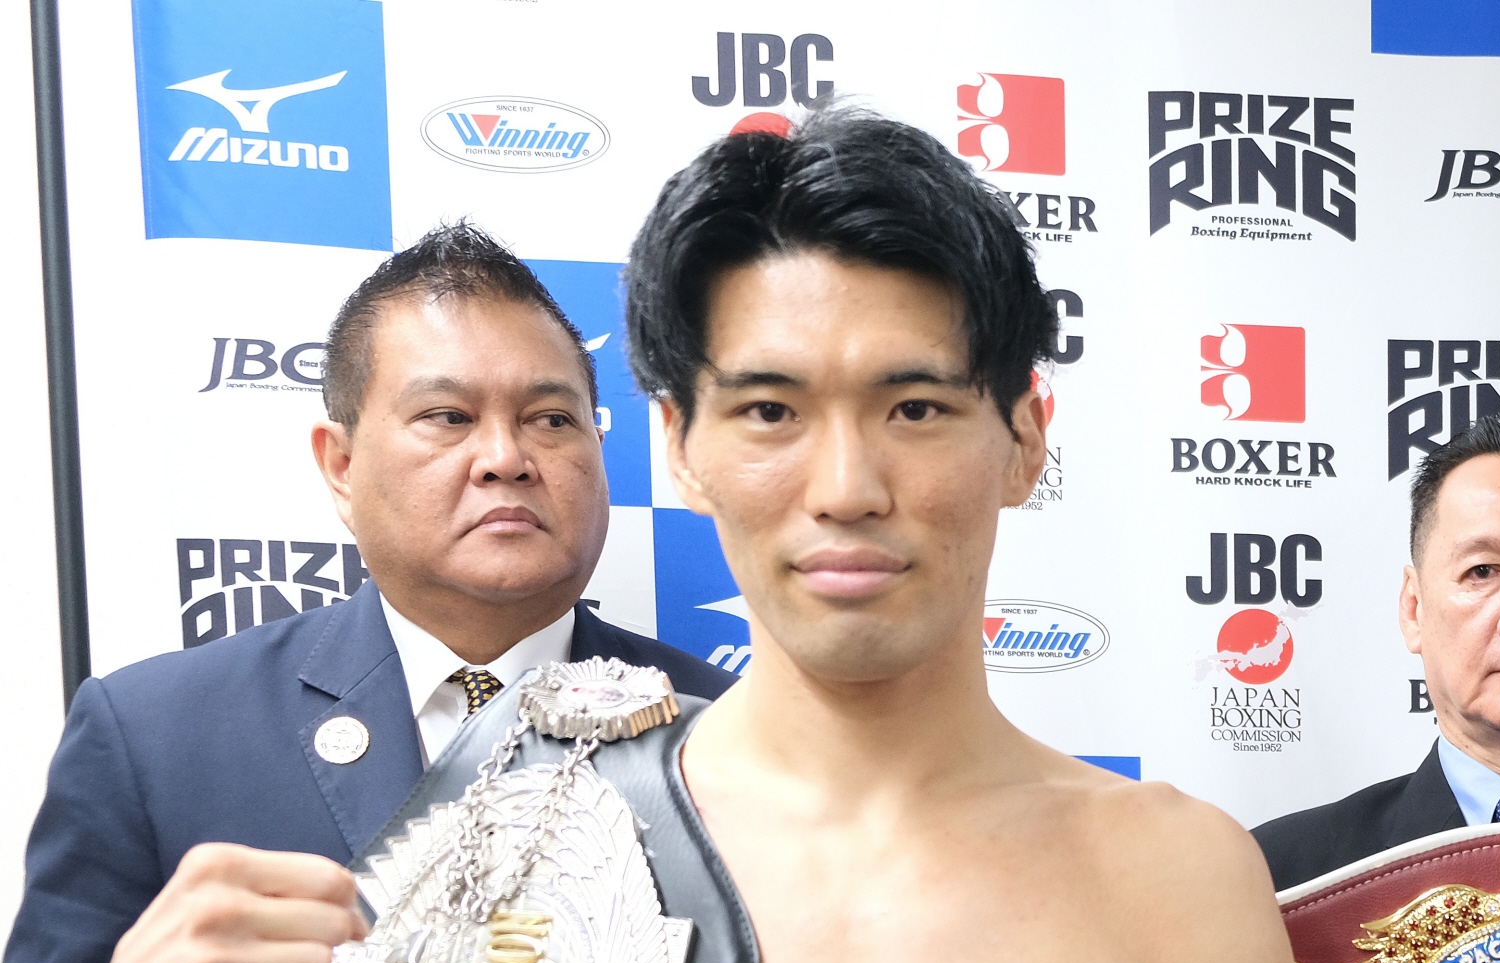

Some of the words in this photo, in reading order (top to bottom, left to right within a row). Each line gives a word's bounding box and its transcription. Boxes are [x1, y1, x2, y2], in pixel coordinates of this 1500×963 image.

[691, 31, 834, 109] JBC
[446, 112, 591, 160] Winning
[1148, 91, 1356, 168] PRIZE
[465, 148, 502, 157] FIGHTING
[503, 149, 532, 158] SPORTS
[534, 151, 562, 159] WORLD
[1149, 137, 1357, 242] RING
[996, 191, 1099, 233] XER
[1211, 215, 1294, 227] PROFESSIONAL
[1045, 232, 1073, 243] LIFE
[1190, 226, 1237, 241] Boxing
[1239, 227, 1313, 242] Equipment
[1170, 438, 1338, 478] BOXER
[1195, 476, 1231, 486] HARD
[1234, 477, 1283, 487] KNOCK
[1285, 479, 1313, 489] LIFE
[1186, 533, 1323, 608] JBC
[1007, 650, 1035, 658] SPORTS
[1210, 686, 1301, 708] JAPAN
[1210, 707, 1302, 729] BOXING
[1211, 729, 1302, 743] COMMISSION
